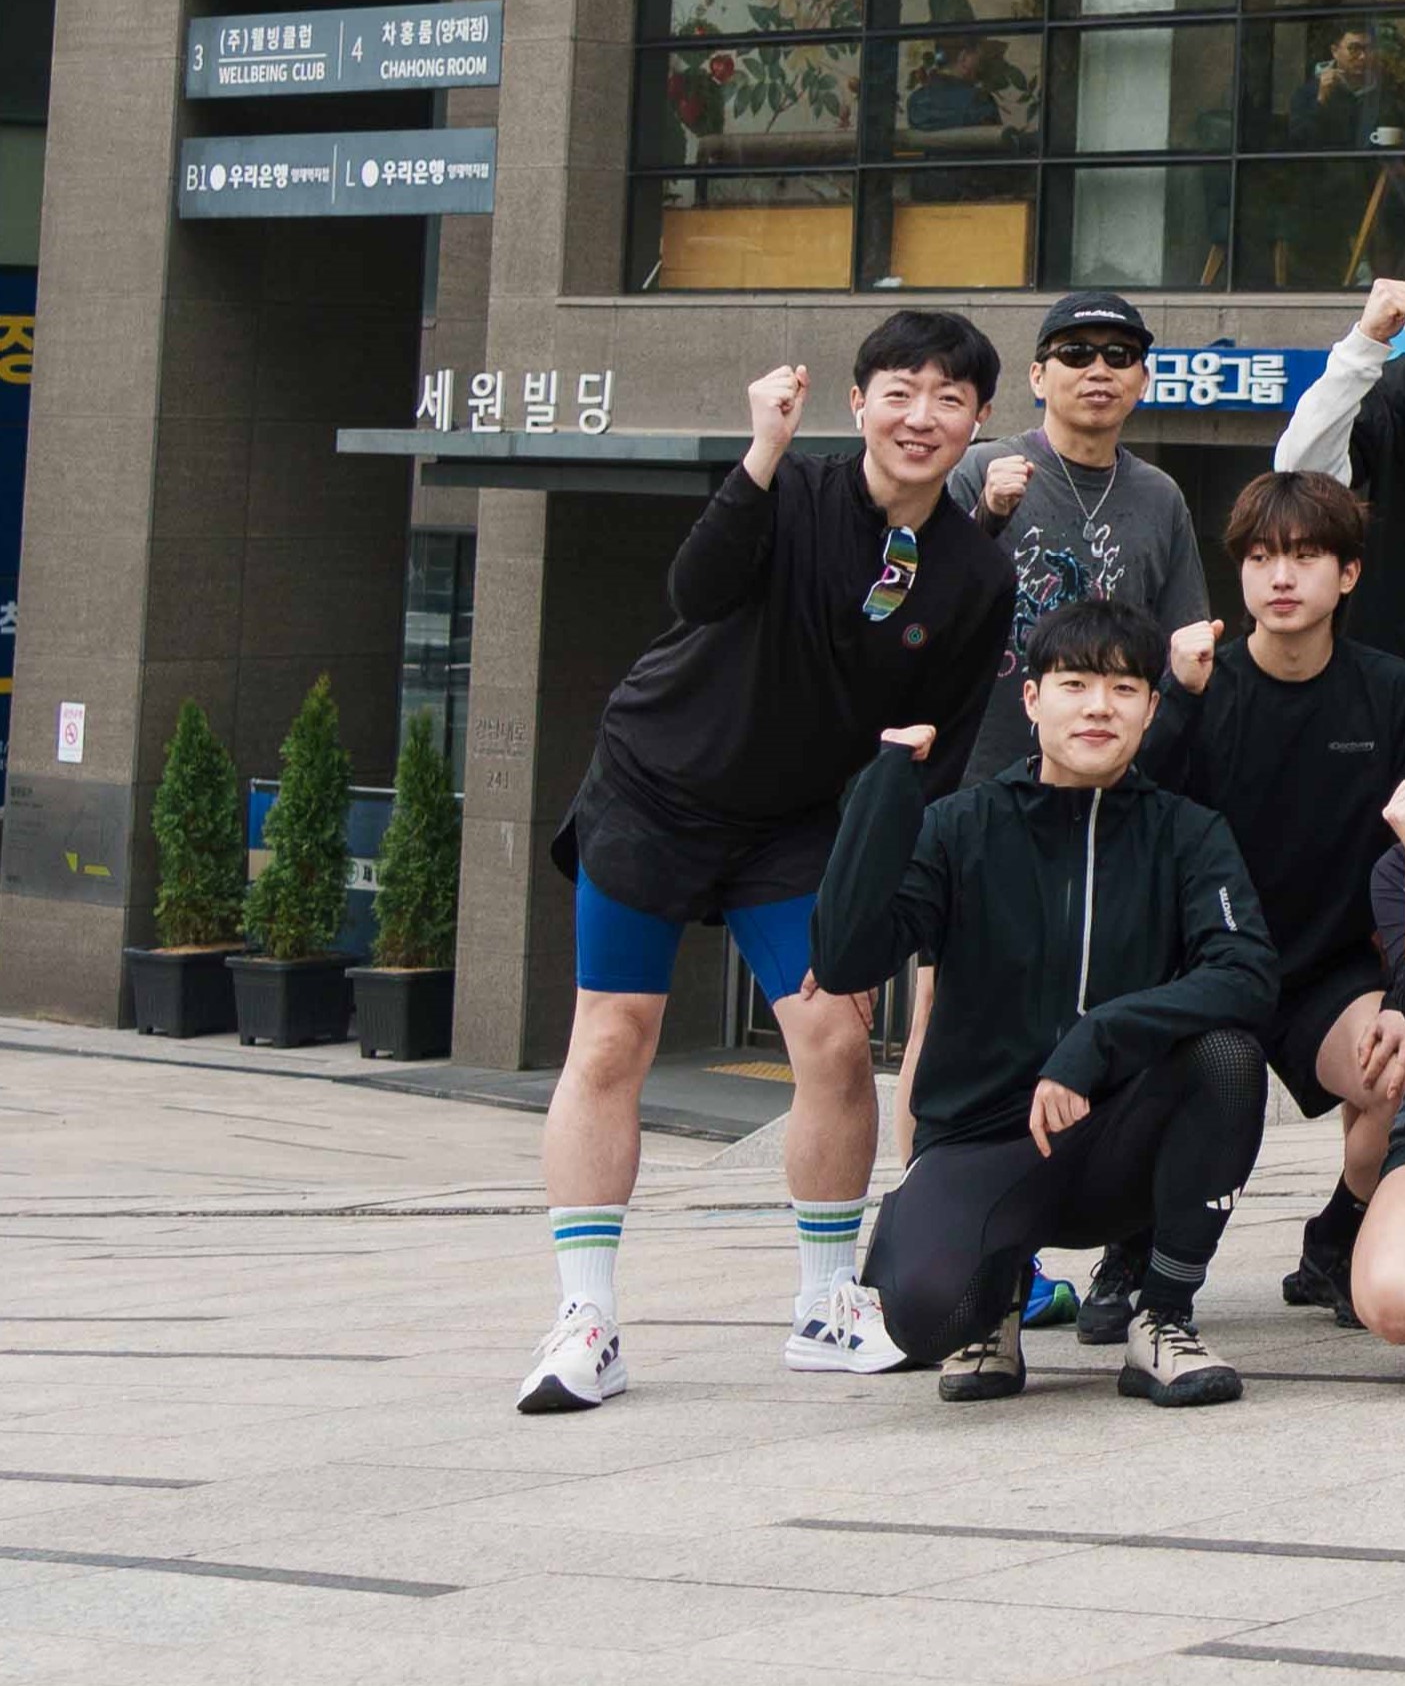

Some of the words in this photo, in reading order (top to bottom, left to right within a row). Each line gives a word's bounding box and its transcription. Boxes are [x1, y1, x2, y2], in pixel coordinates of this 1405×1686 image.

[193, 44, 204, 71] 3
[351, 36, 363, 62] 4
[219, 64, 287, 84] WELLBEING
[292, 62, 325, 81] CLUB
[380, 58, 445, 79] CHAHONG
[447, 56, 487, 75] ROOM
[186, 165, 207, 191] B1
[229, 164, 288, 189] 우리은행
[381, 160, 445, 186] 우리은행
[416, 369, 613, 435] 세원빌딩
[486, 769, 509, 789] 241
